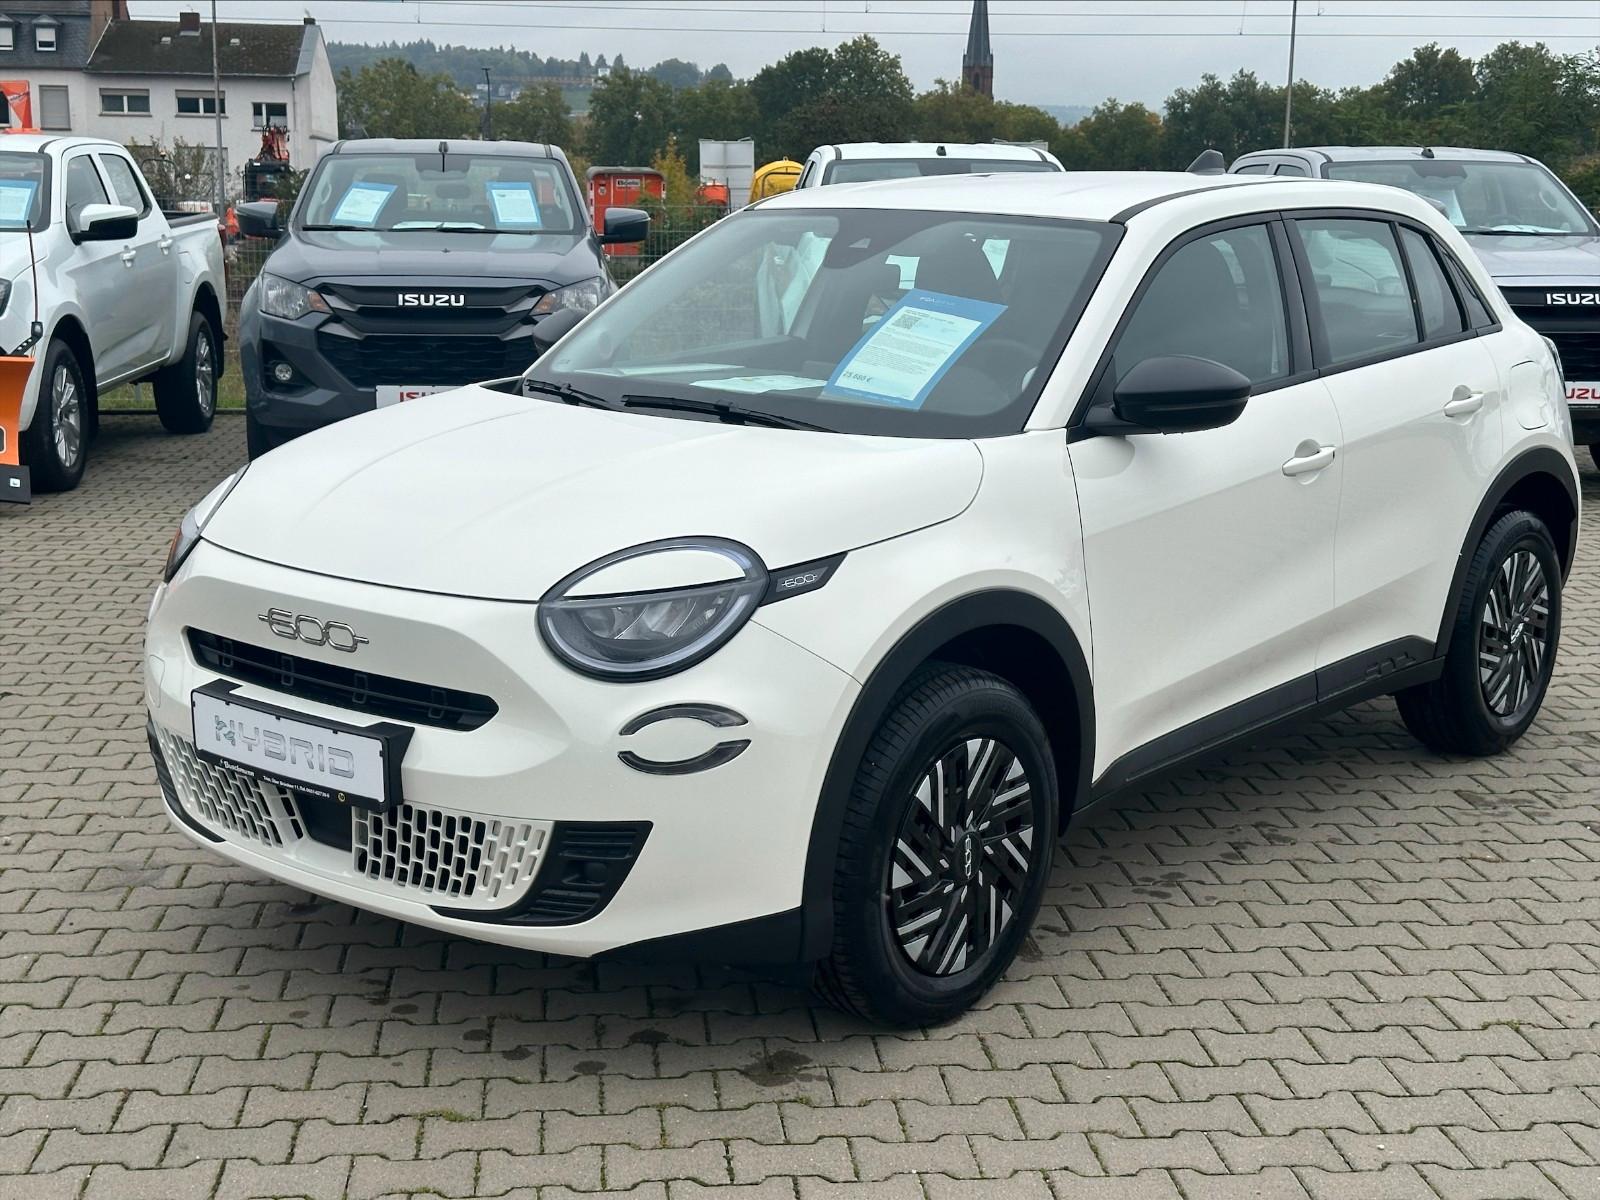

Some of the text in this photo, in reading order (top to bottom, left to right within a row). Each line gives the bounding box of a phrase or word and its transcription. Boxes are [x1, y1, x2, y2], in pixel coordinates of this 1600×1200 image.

[398, 293, 465, 306] ISUZU
[782, 573, 818, 588] 600
[258, 607, 369, 653] 600
[214, 714, 355, 779] HYBRID
